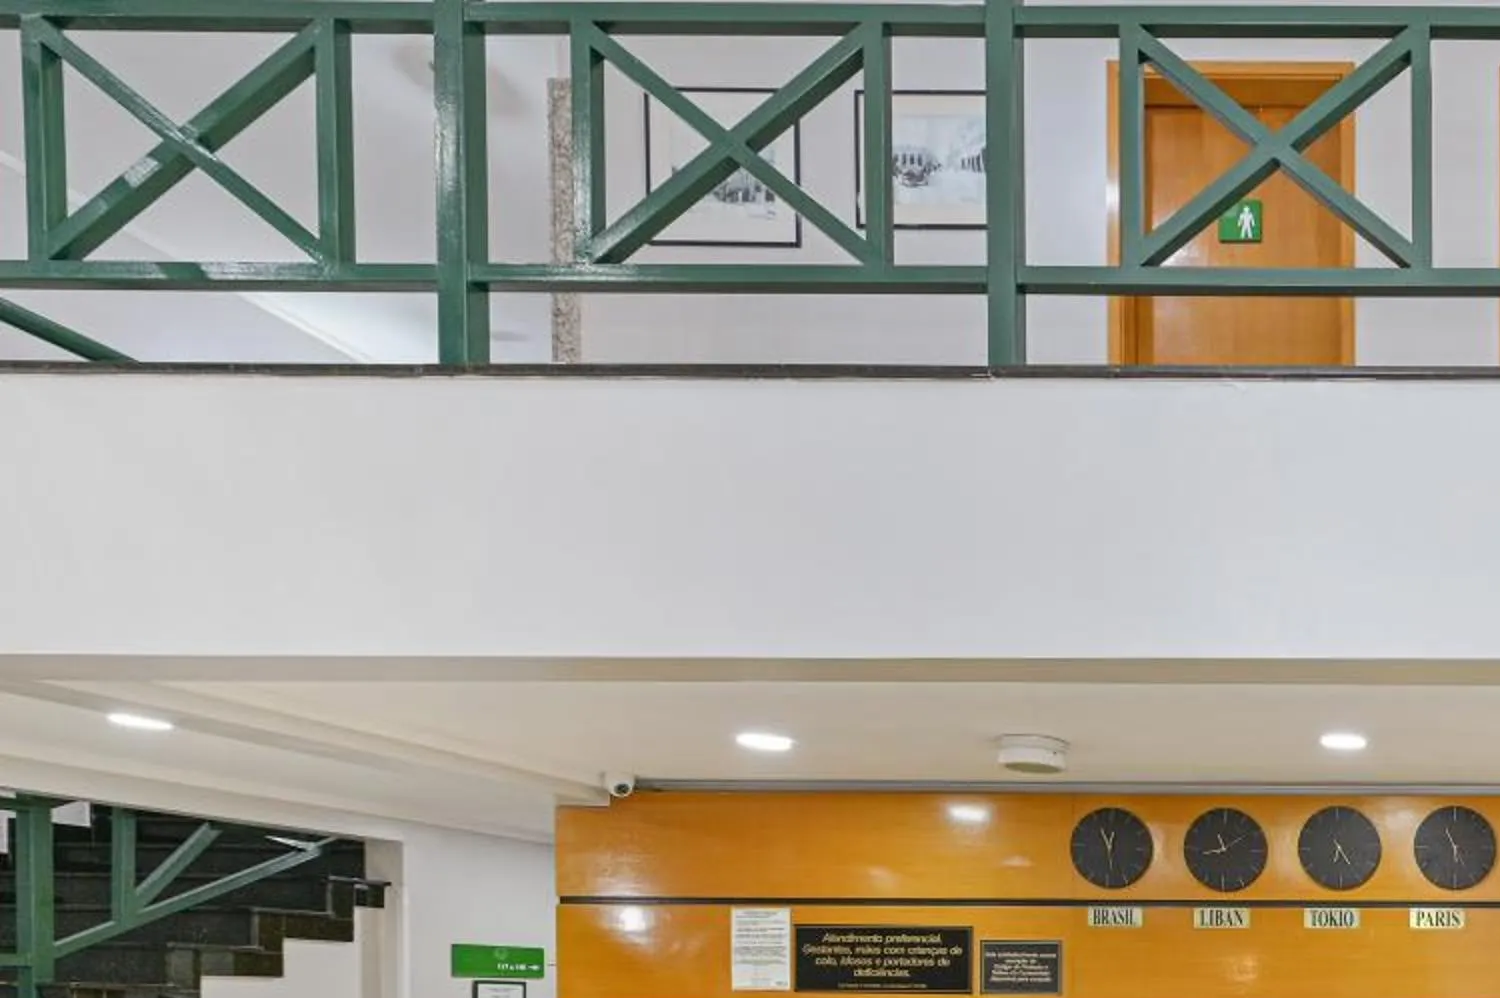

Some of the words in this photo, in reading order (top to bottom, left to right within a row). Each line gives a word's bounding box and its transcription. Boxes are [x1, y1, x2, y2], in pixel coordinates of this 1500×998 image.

[1093, 908, 1136, 925] BRASIL
[1200, 909, 1244, 926] LIBAN
[1310, 909, 1354, 927] TOKIO
[1415, 910, 1461, 927] PARIS
